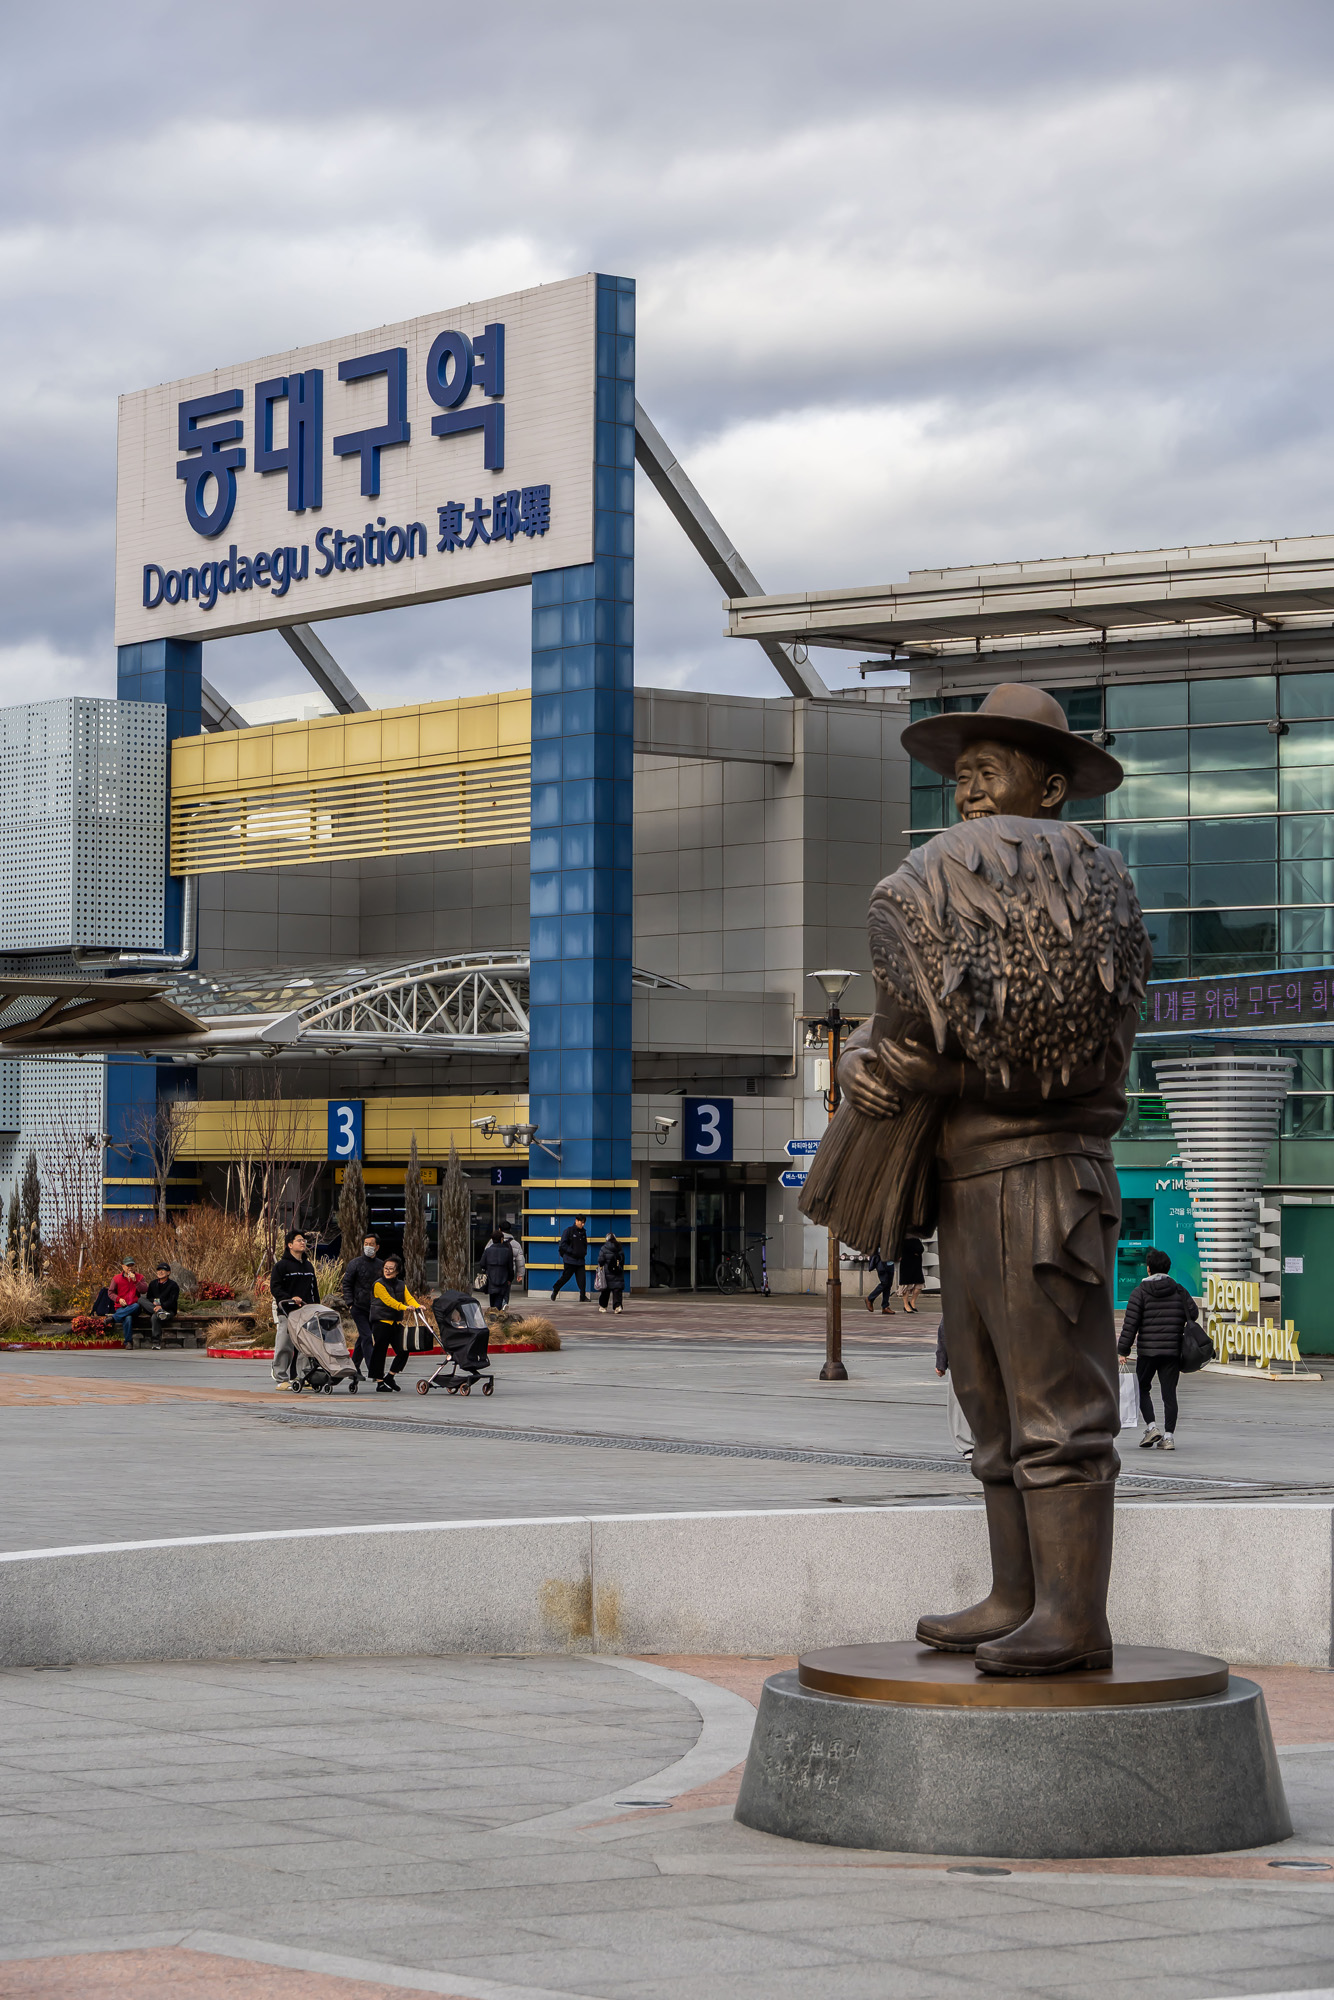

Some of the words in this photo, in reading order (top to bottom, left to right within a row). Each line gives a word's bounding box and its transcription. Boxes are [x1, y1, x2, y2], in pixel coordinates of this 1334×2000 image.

[176, 322, 505, 537] 동대구역
[142, 544, 309, 610] Dongdaegu
[314, 516, 427, 576] Station
[436, 484, 551, 552] 東大邱驛
[1204, 986, 1239, 1019] 위한
[1247, 981, 1301, 1015] 모두의
[1311, 979, 1334, 1012] 희
[336, 1106, 355, 1155] 3
[696, 1104, 722, 1154] 3
[496, 1169, 502, 1183] 3
[1206, 1273, 1257, 1322] Daegu
[1207, 1315, 1300, 1369] Gyeongbuk
